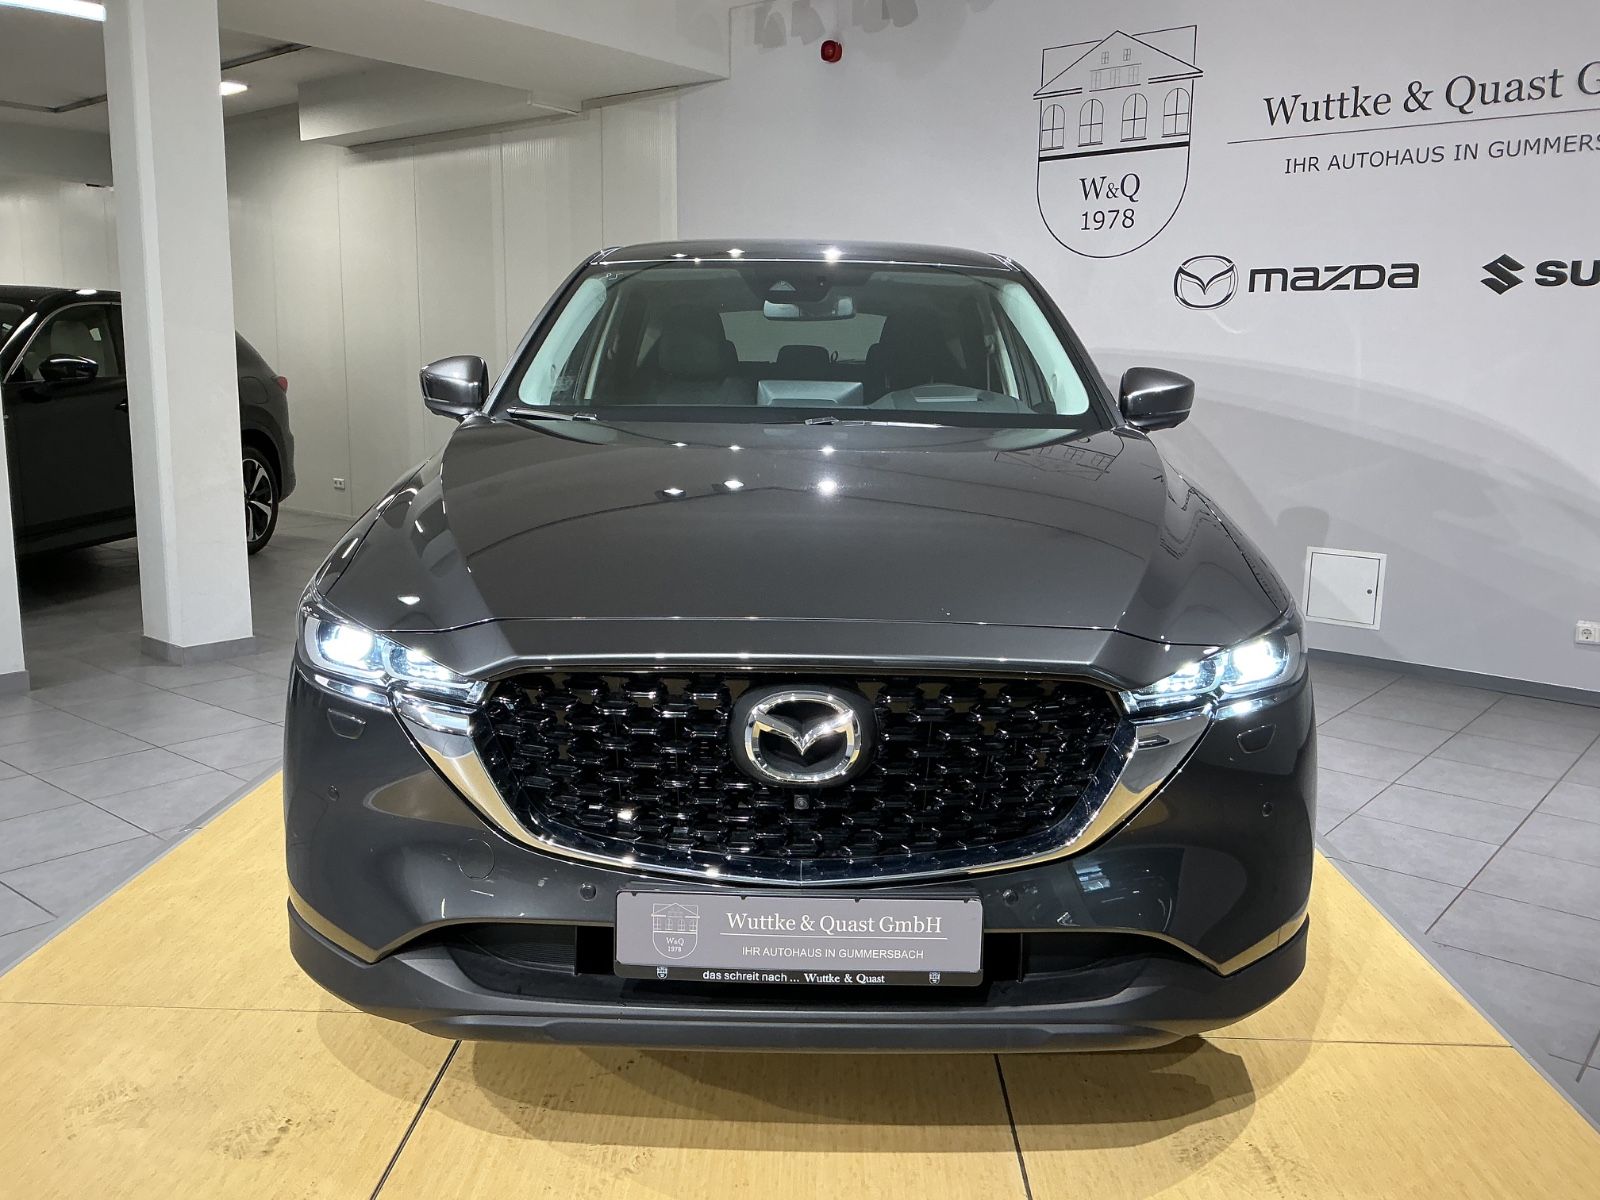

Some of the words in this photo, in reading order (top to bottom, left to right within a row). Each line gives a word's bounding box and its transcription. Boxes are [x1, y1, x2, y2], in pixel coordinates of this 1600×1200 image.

[1263, 85, 1392, 126] Wuttke
[1403, 80, 1434, 113] &
[1445, 68, 1564, 115] Quast
[1285, 156, 1320, 174] IHR
[1327, 145, 1445, 171] AUTOHAUS
[1453, 143, 1478, 161] IN
[1079, 173, 1141, 203] W&Q
[1081, 208, 1135, 231] 1978
[1534, 259, 1600, 287] SU
[726, 912, 796, 931] Wuttke
[800, 914, 816, 932] &
[819, 915, 875, 935] Quast
[878, 916, 942, 933] GmbH
[742, 946, 761, 956] IHR
[762, 946, 822, 958] AUTOHAUS
[825, 949, 836, 958] IN
[838, 949, 924, 959] GUMMERSBACH
[702, 970, 721, 980] das
[723, 971, 760, 982] schreit
[761, 973, 788, 983] nach
[804, 973, 840, 983] Wuttke
[844, 973, 853, 983] &
[856, 974, 885, 985] Quast
